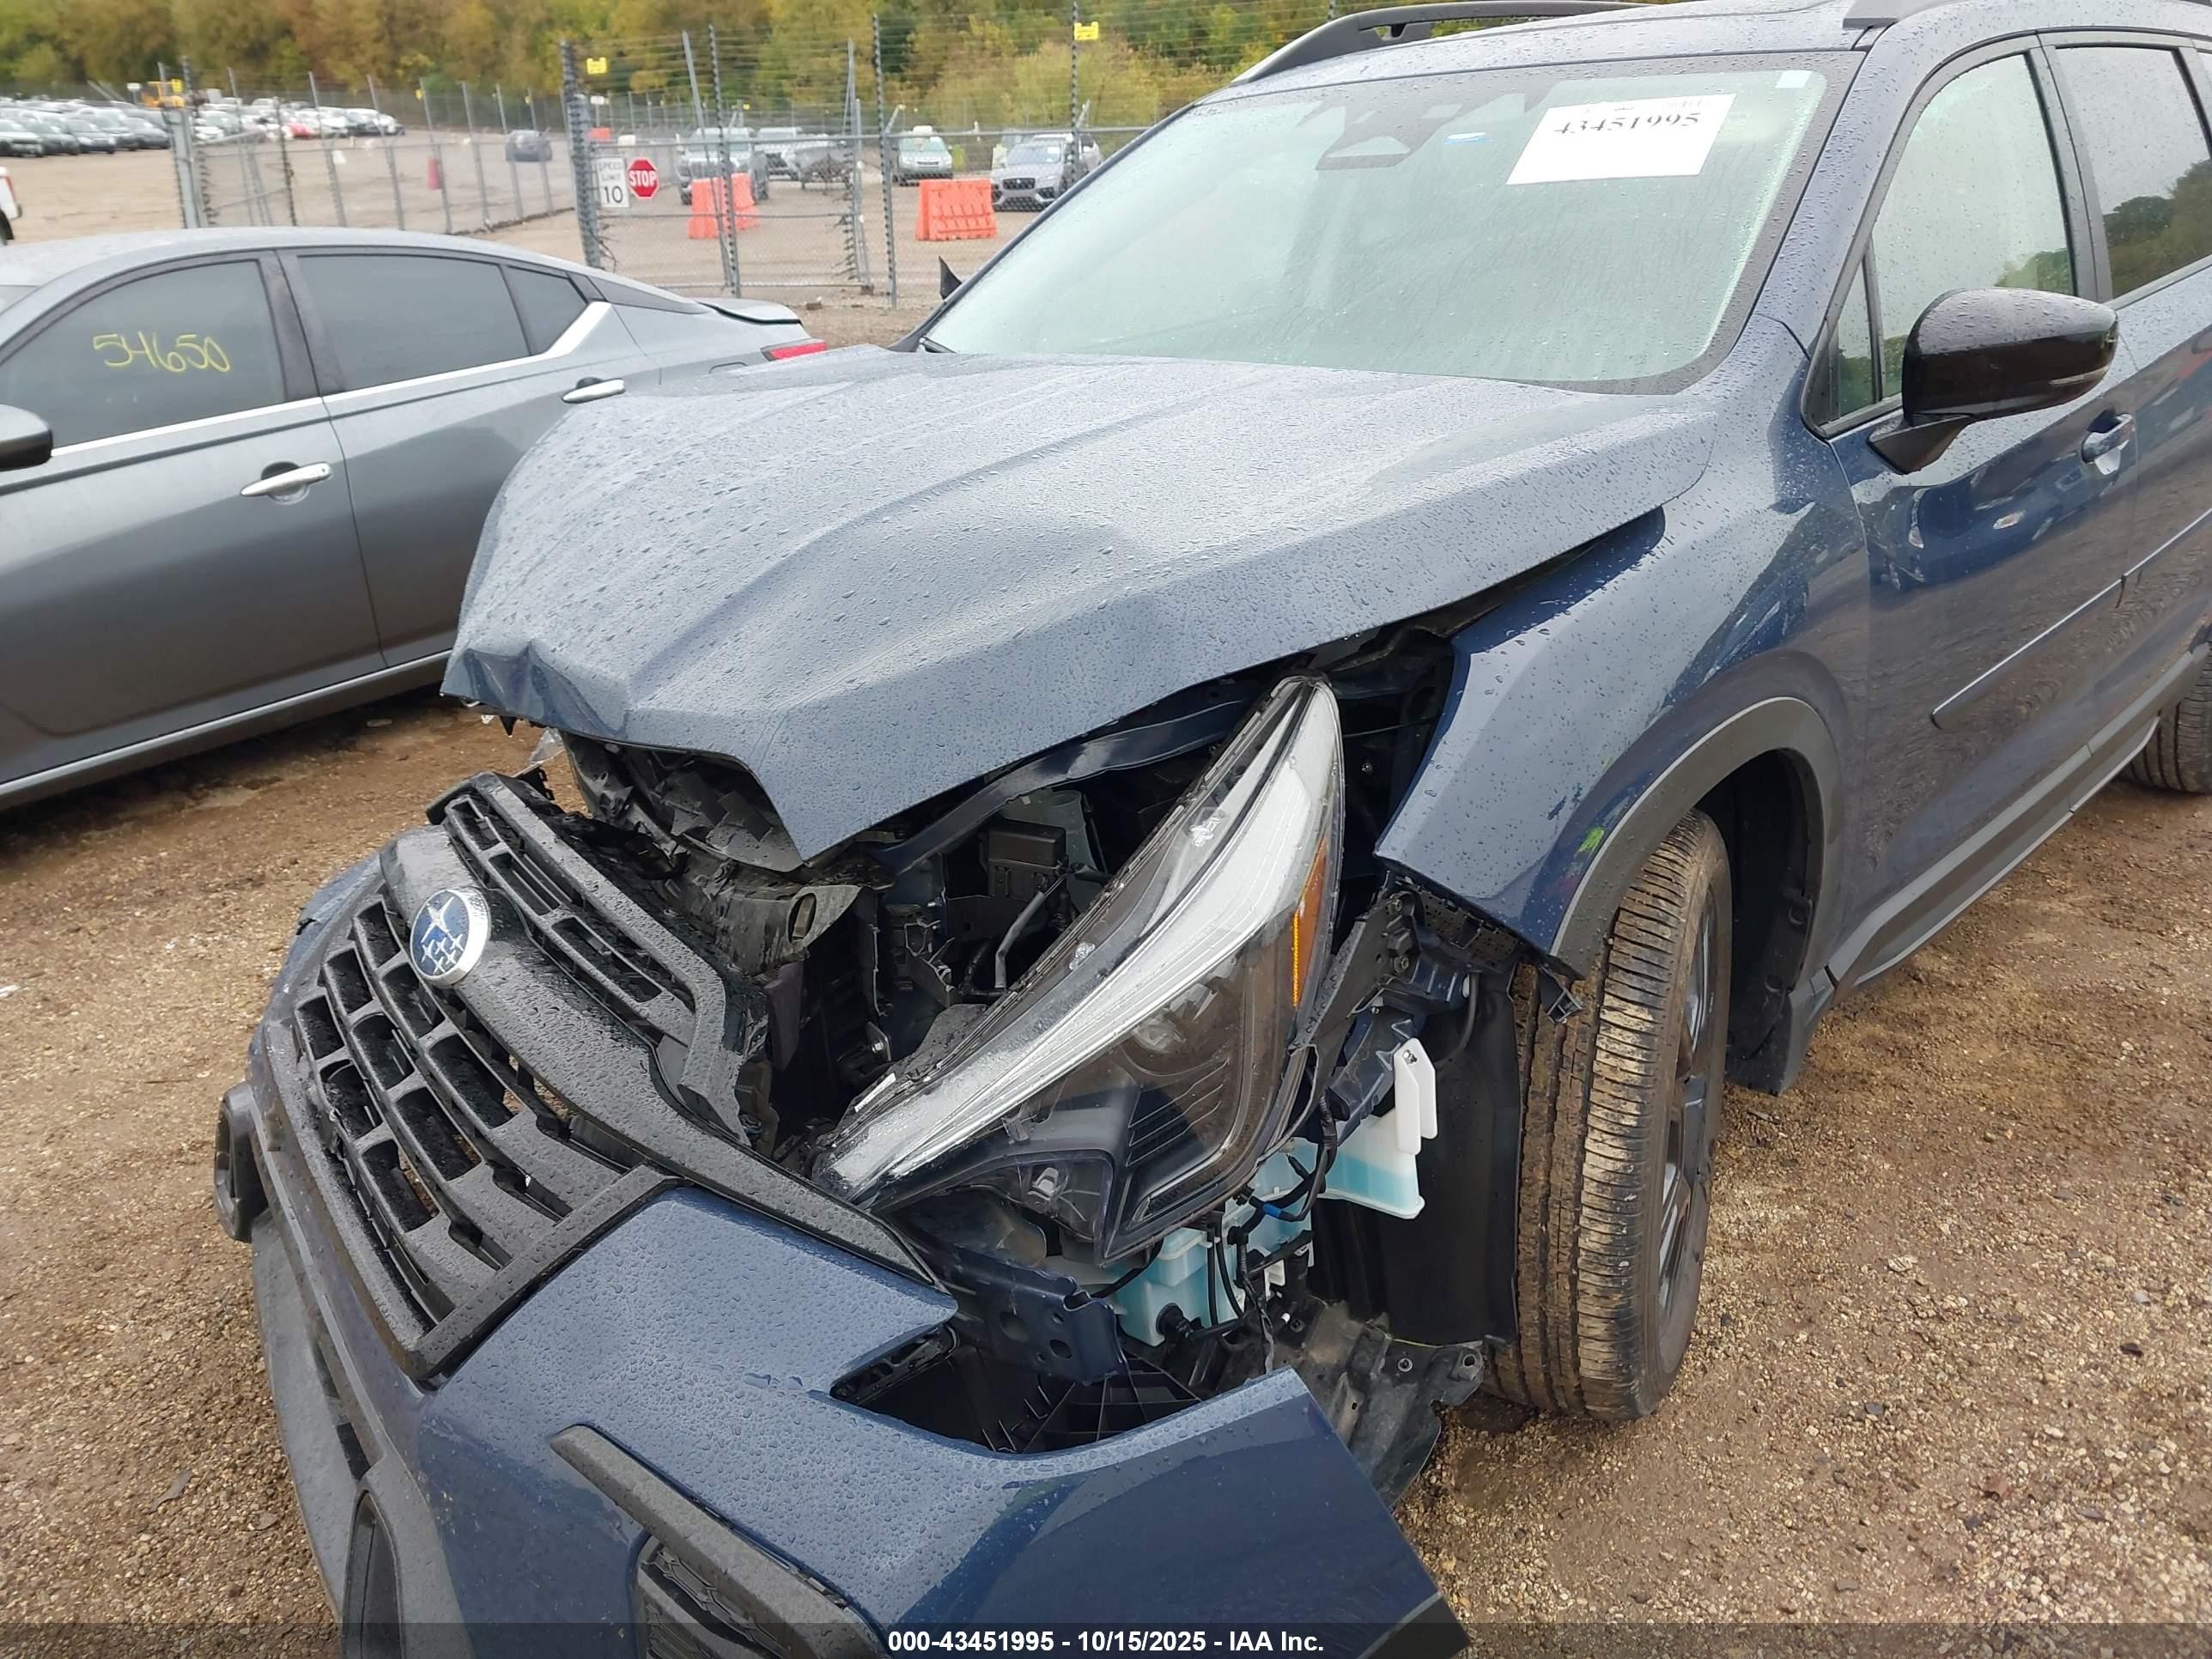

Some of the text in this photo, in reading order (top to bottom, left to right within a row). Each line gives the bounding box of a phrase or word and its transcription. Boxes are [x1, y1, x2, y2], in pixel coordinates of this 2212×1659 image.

[1554, 112, 1702, 135] 43451995
[629, 170, 657, 187] STOP
[604, 185, 623, 204] 10
